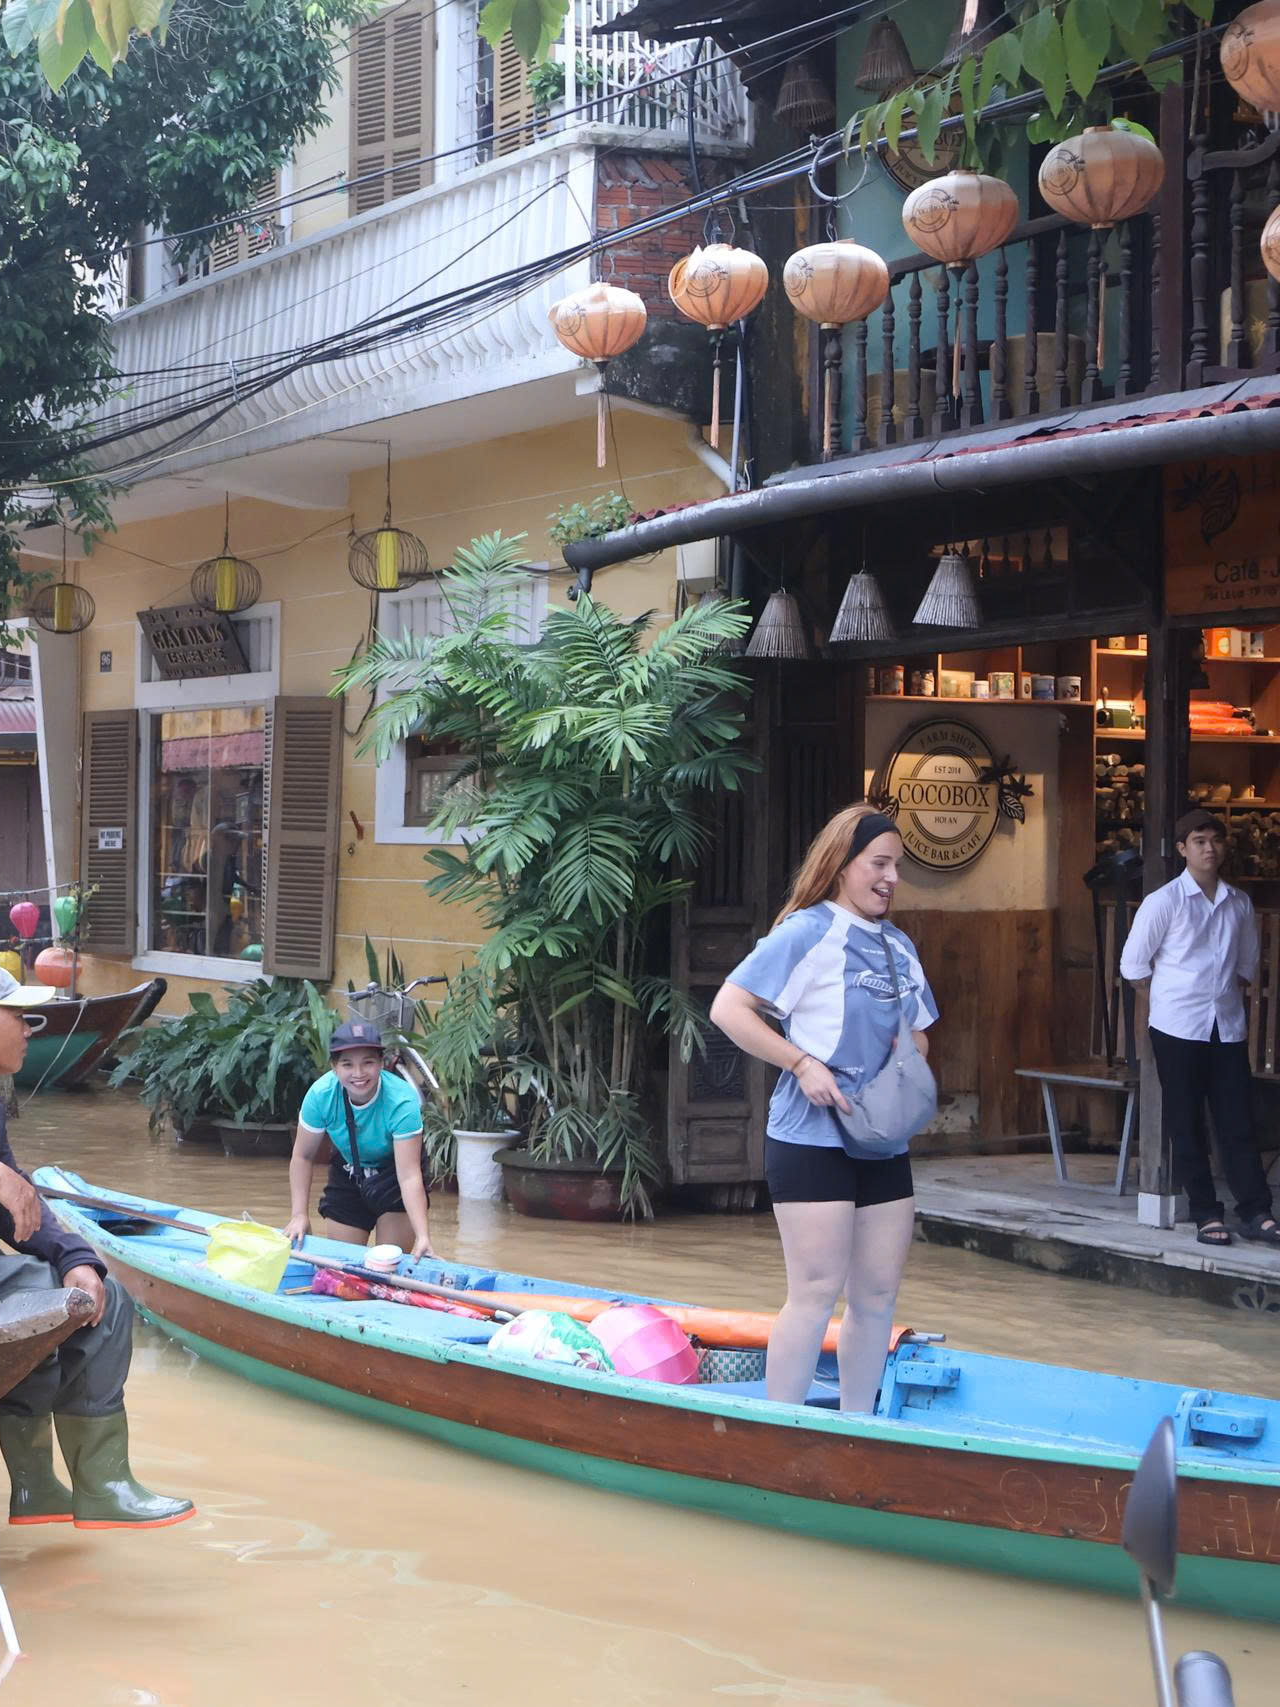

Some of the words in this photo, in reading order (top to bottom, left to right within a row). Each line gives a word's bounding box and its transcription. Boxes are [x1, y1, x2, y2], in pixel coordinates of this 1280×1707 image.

[920, 731, 948, 749] FARM
[898, 783, 990, 808] COCOBOX
[903, 830, 930, 857] JUICE
[931, 848, 951, 861] BAR
[952, 848, 960, 860] &
